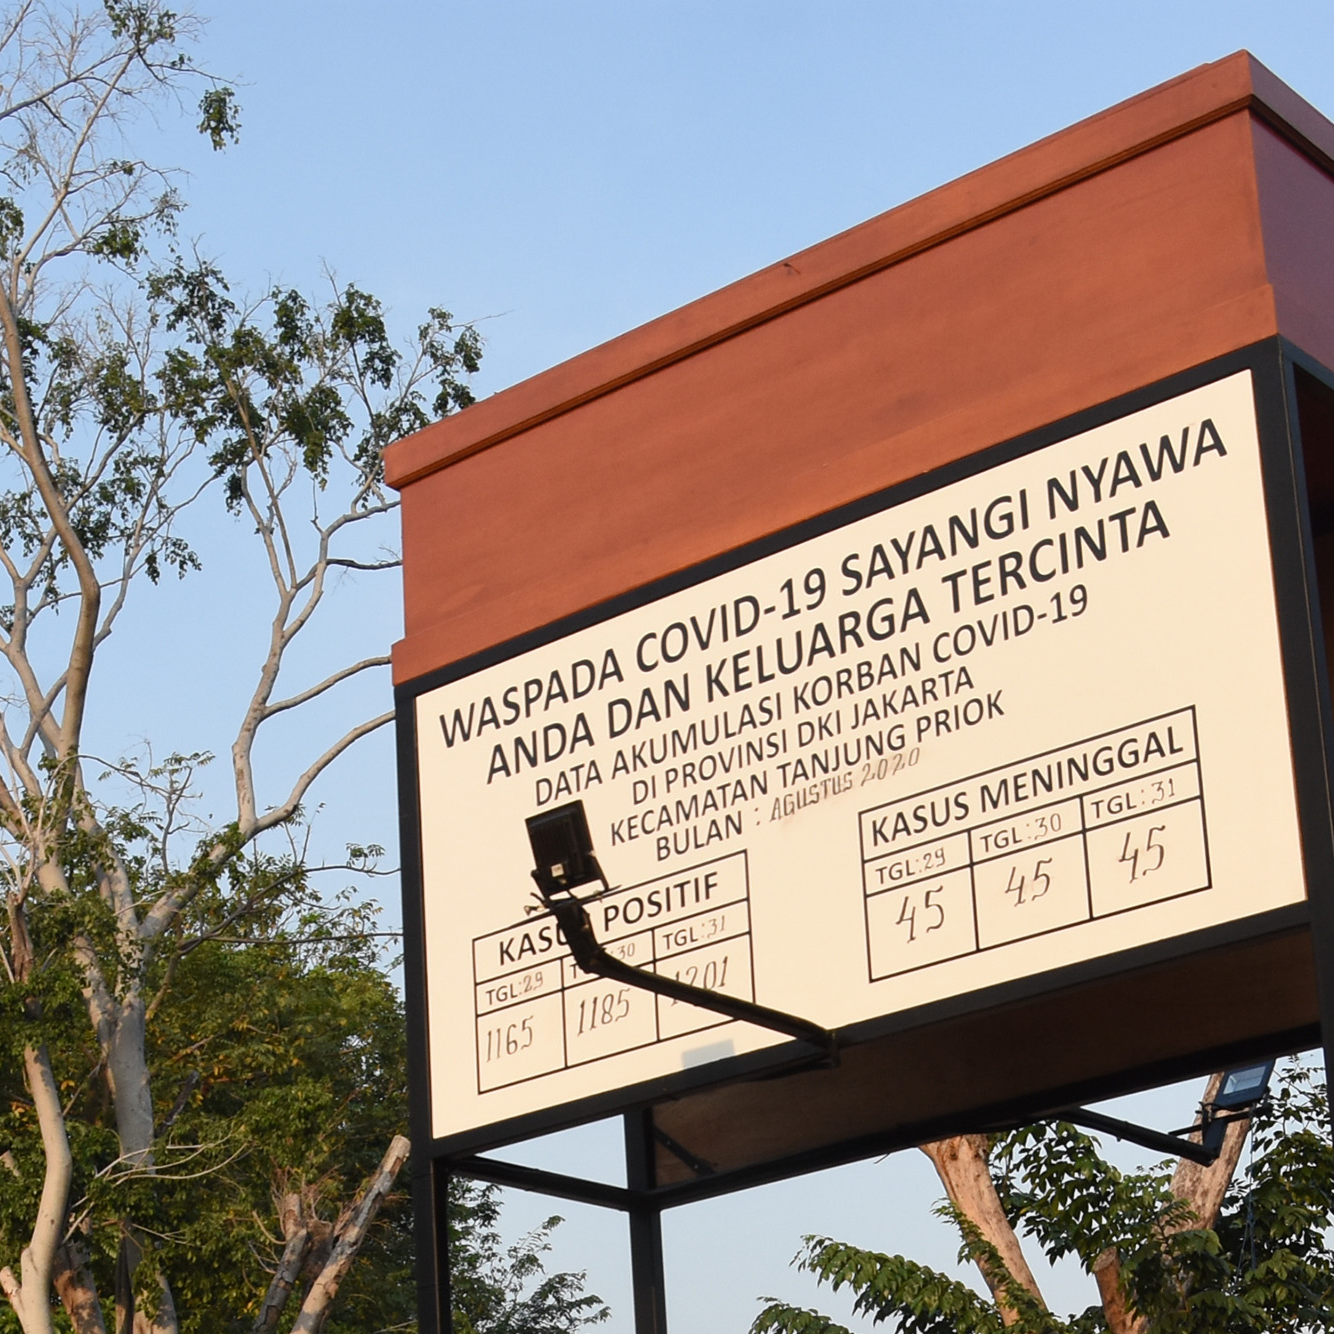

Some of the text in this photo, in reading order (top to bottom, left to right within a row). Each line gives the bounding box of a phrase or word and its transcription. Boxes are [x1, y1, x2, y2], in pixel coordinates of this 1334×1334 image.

[439, 418, 1228, 749] WASPADA COVID-19 SAYANGI NYAWA
[487, 499, 1170, 784] ANDA DAN KELUARGA TERCINTA
[535, 584, 1088, 806] DATA AKUMULASI KORBAN COVID-19
[632, 665, 974, 806] DI PROVINSI DKI JAKARTA
[611, 690, 1005, 846] KECAMATAN TANJUNG PRIOK
[656, 810, 743, 862] BULAN
[769, 771, 853, 822] AGUSTUS
[861, 747, 920, 787] 2020
[872, 726, 1184, 847] KASUS MENINGGAL
[499, 872, 718, 966] KASU POSITIF
[894, 824, 1167, 943] 45 45 45
[485, 1015, 534, 1063] 1165
[576, 987, 631, 1037] 1185
